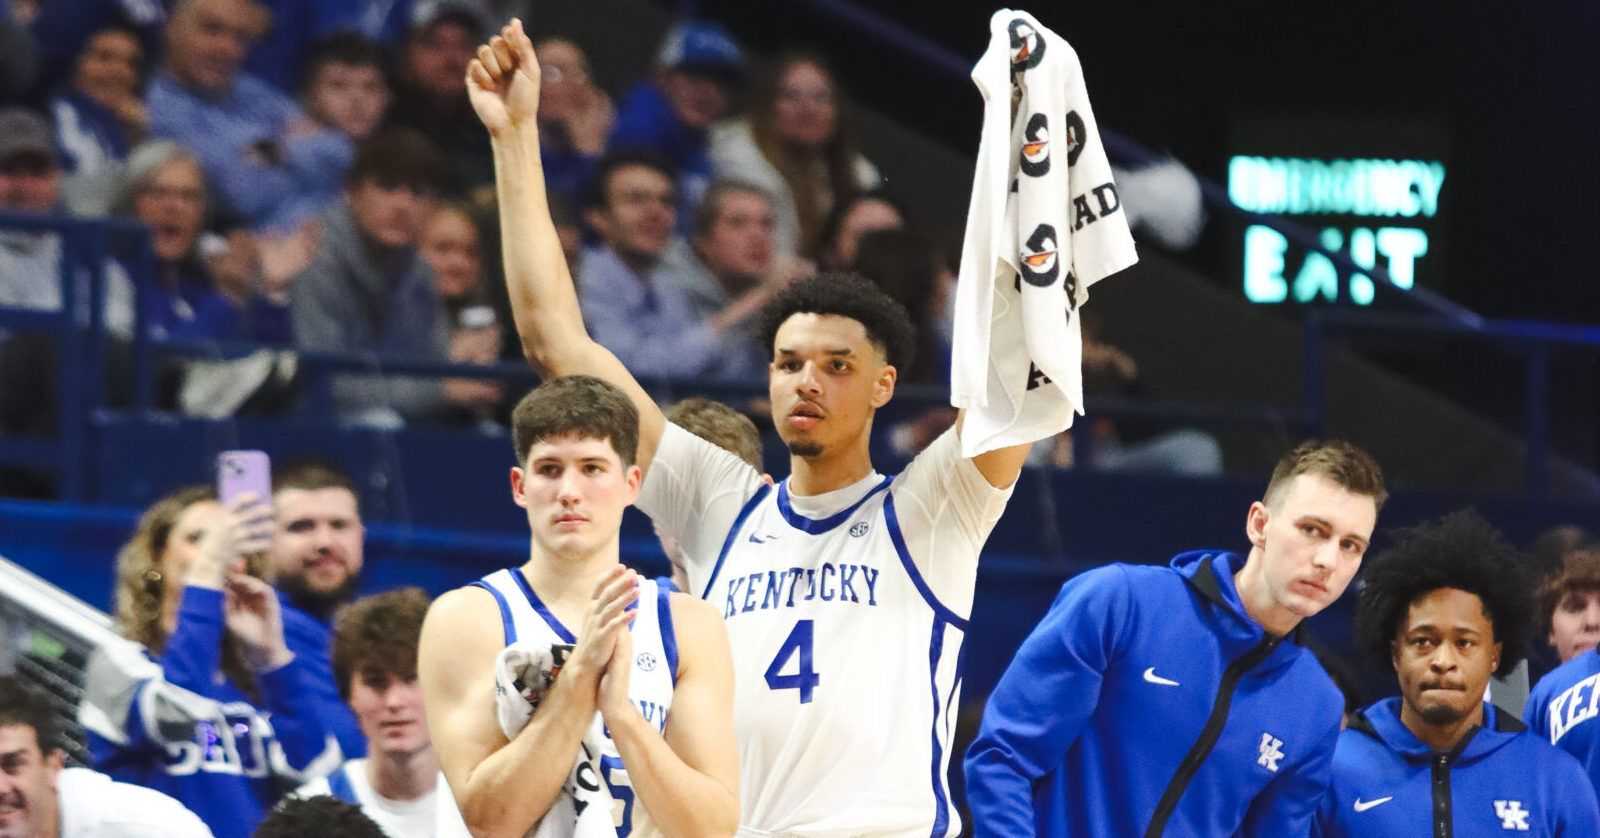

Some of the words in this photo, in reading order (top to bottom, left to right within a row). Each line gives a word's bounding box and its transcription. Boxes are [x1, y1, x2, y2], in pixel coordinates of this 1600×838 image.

[849, 521, 869, 538] SEC
[724, 562, 879, 620] KENTUCKY
[764, 619, 820, 704] 4
